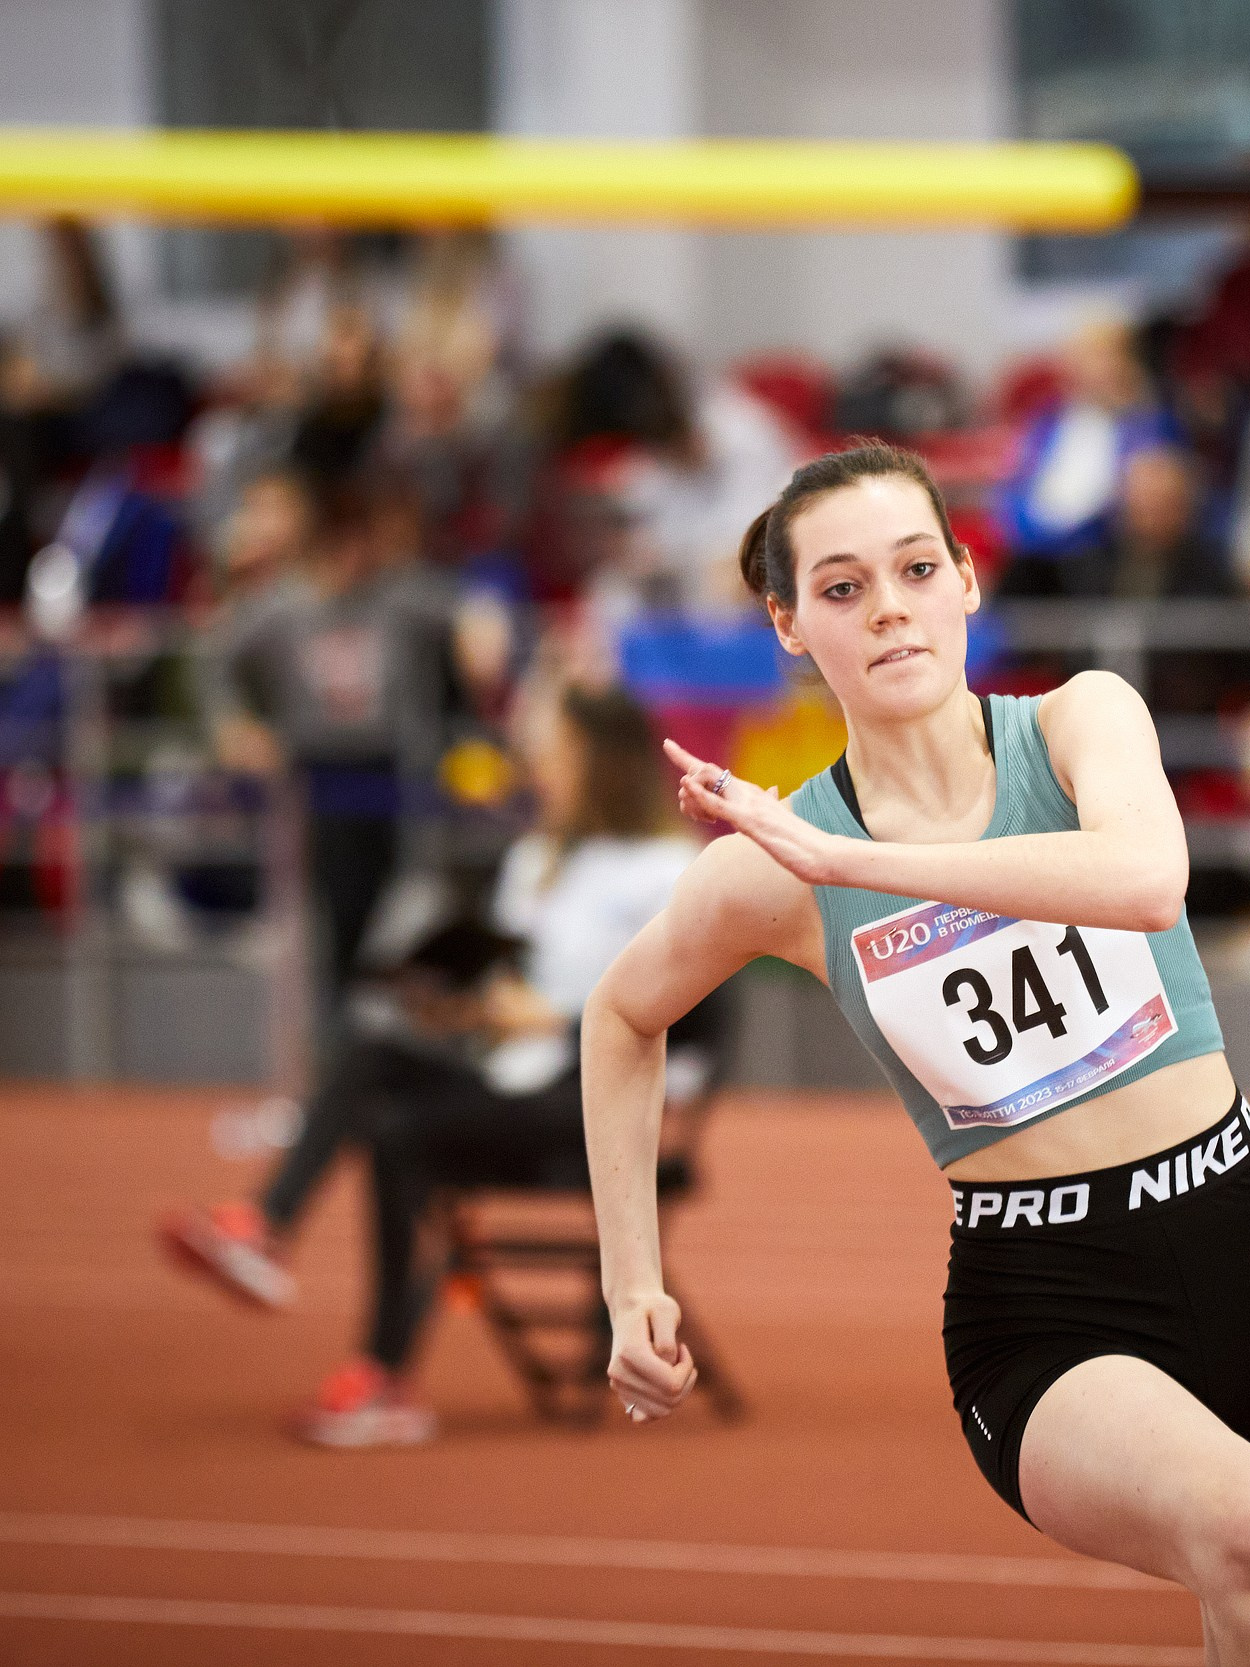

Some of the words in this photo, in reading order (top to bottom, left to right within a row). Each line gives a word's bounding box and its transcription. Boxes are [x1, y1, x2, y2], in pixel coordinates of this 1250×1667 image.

[933, 907, 978, 927] ПЕРВЕ
[937, 927, 949, 938] В
[869, 922, 931, 960] U20
[942, 925, 1110, 1066] 341
[1018, 1086, 1053, 1110] 2023
[1076, 1058, 1116, 1084] ФЕВРАЛЯ
[968, 1183, 1090, 1228] PRO
[1128, 1116, 1250, 1210] NIKE
